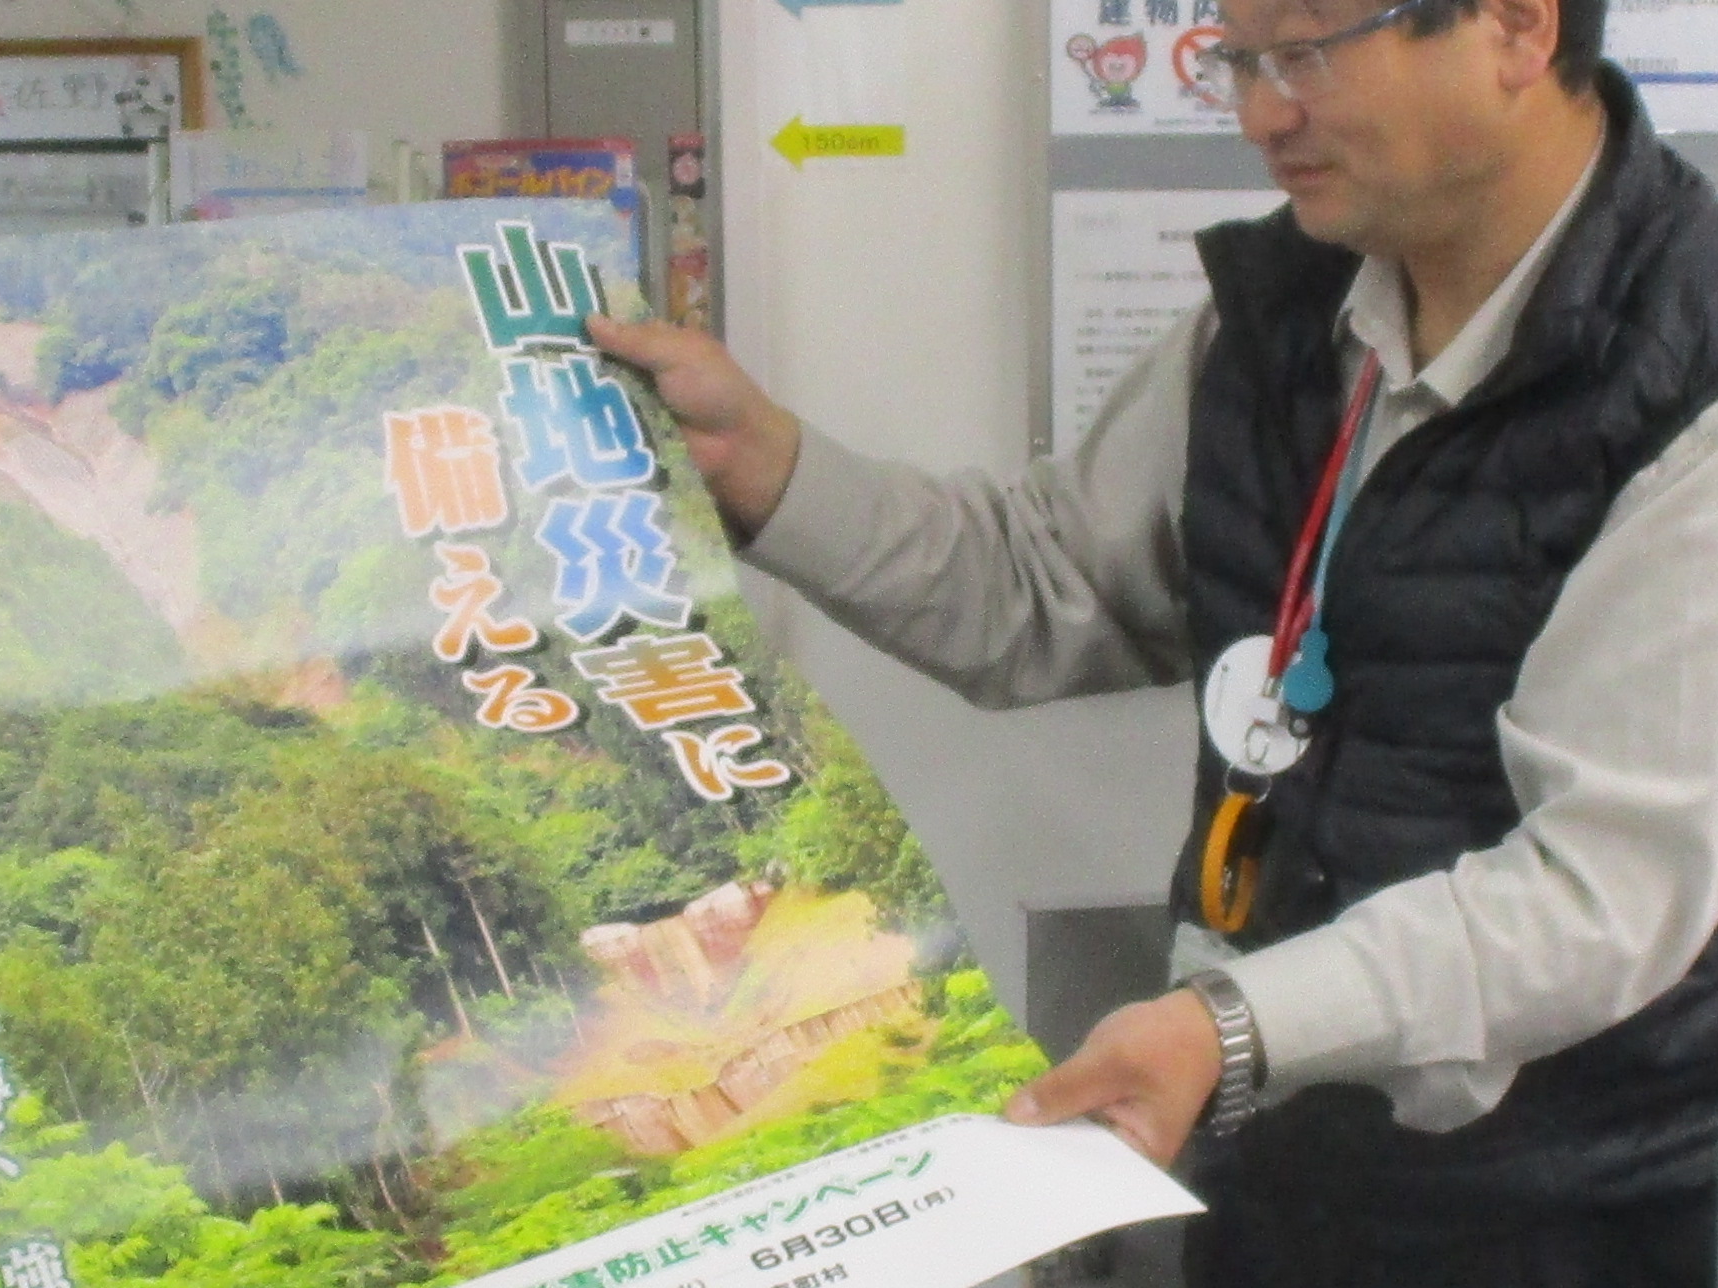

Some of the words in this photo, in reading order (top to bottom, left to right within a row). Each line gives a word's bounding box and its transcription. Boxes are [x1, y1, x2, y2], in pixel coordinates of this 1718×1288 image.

[802, 131, 880, 151] 150cm
[383, 405, 579, 735] 備える
[456, 220, 790, 801] 山地災害に
